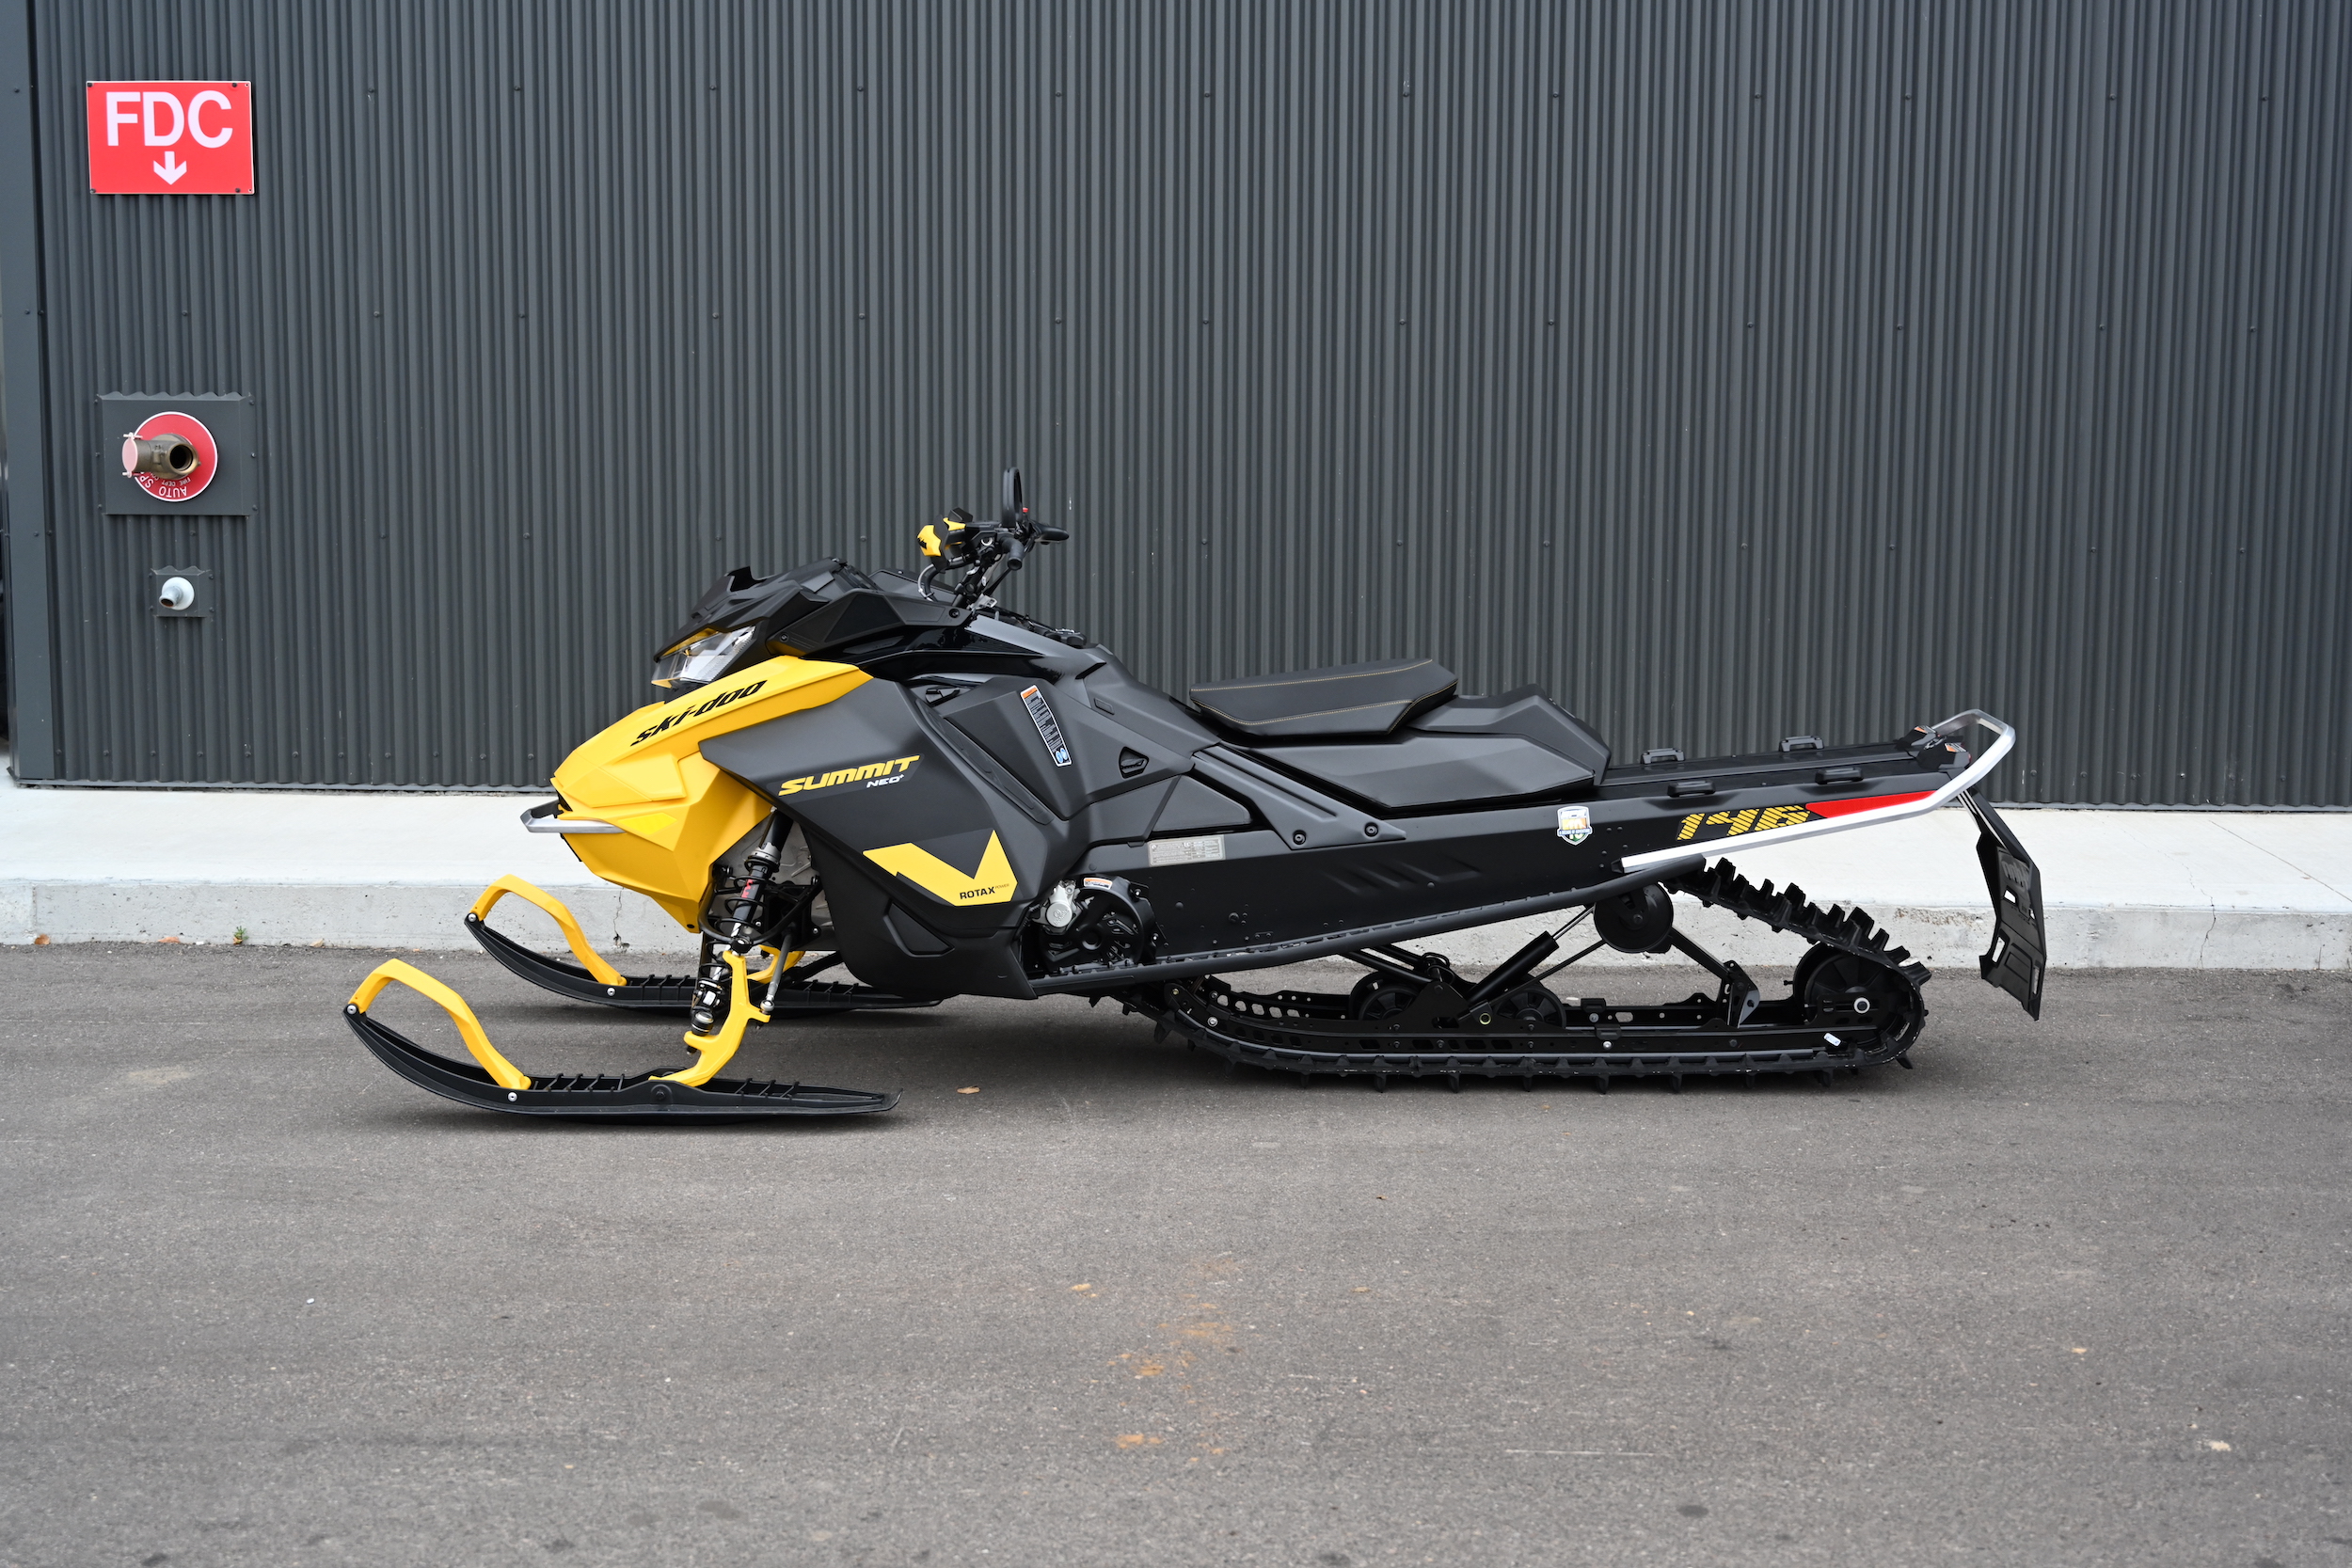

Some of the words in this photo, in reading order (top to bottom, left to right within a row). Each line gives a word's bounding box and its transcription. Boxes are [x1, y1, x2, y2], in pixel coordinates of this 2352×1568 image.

[106, 90, 233, 149] FDC
[158, 486, 187, 498] AUTO
[778, 755, 920, 797] SUMMIT
[1677, 805, 1811, 841] 146
[960, 886, 995, 900] ROTAX
